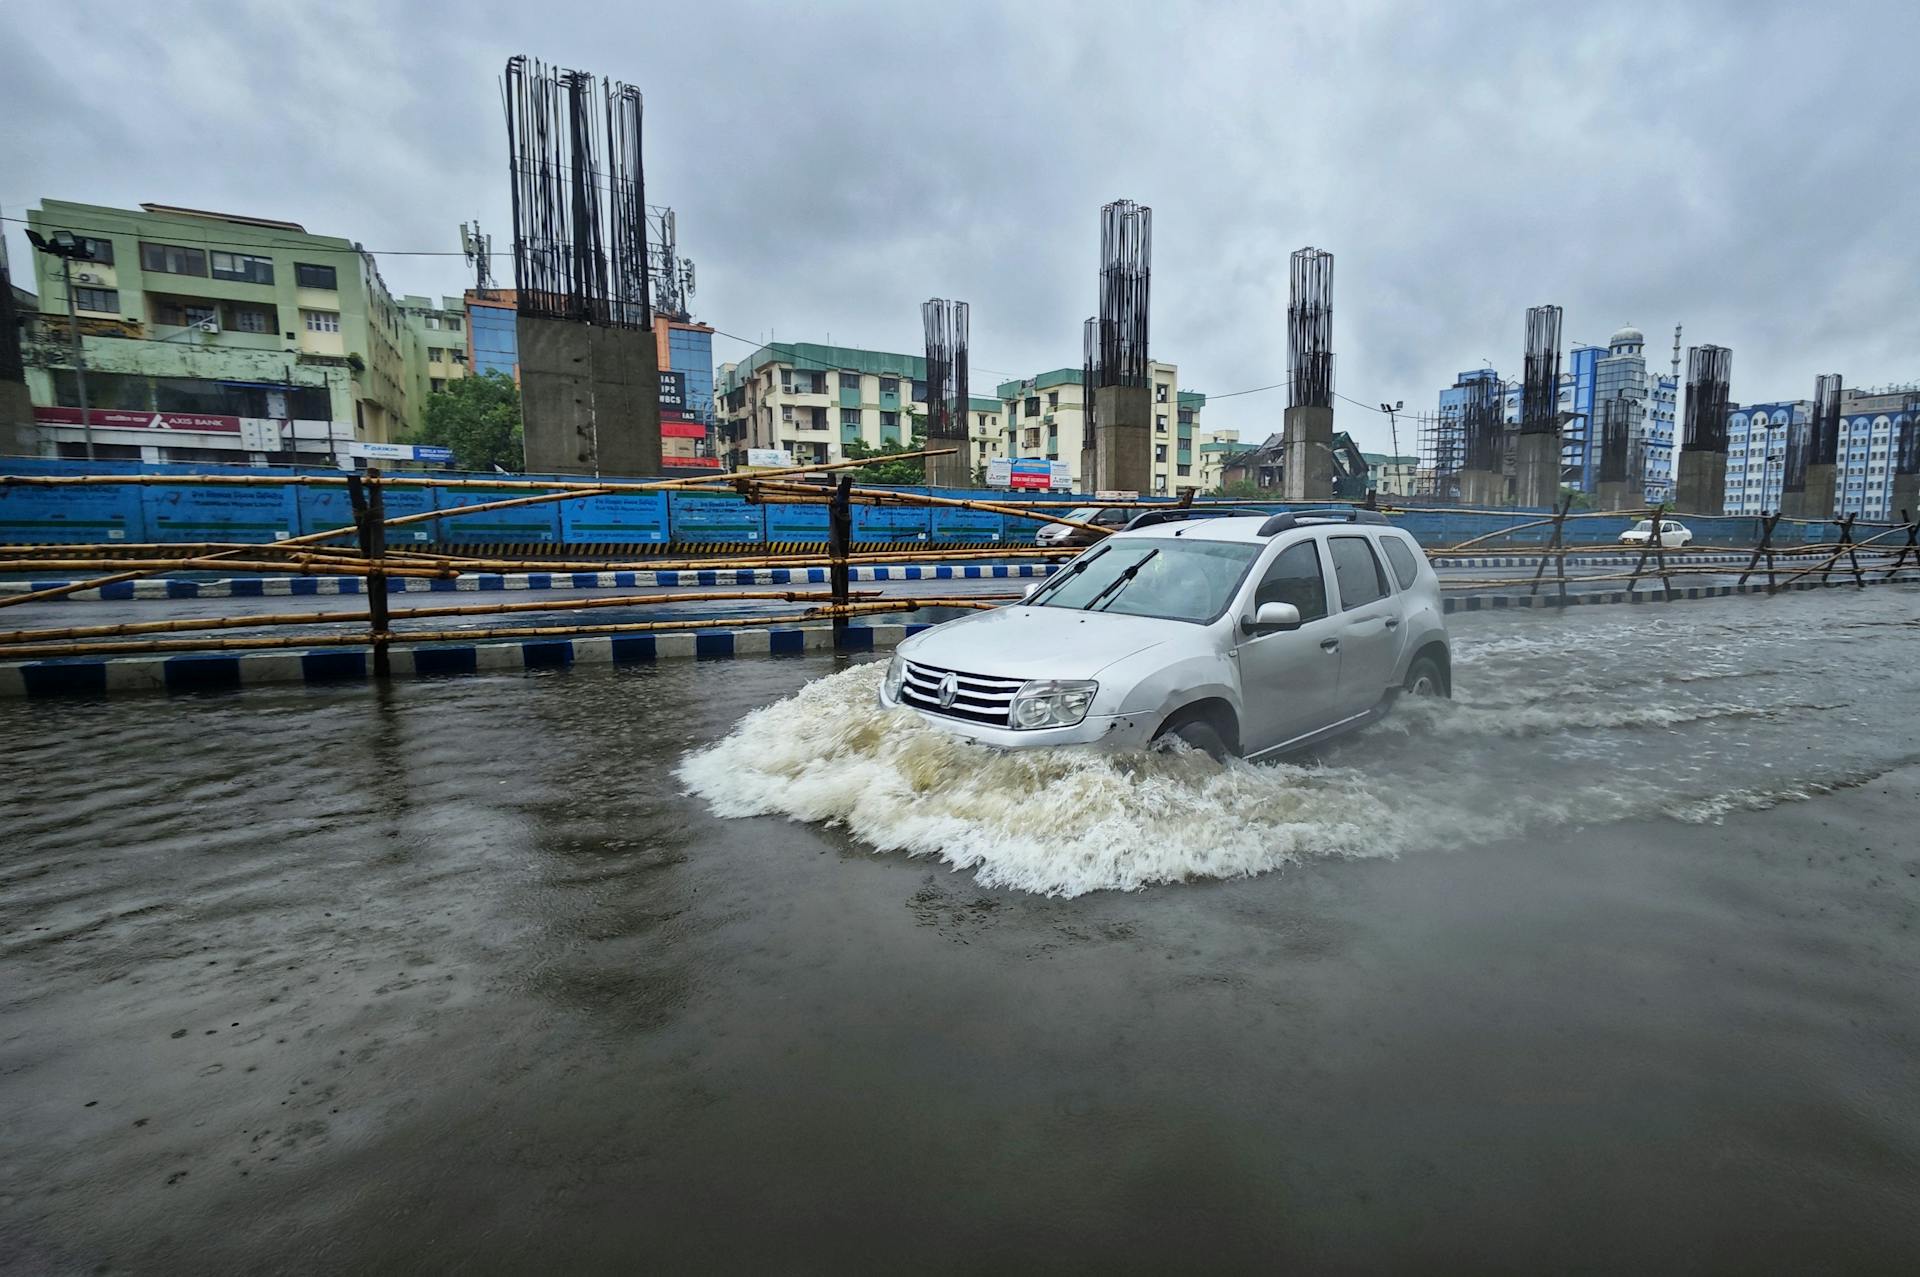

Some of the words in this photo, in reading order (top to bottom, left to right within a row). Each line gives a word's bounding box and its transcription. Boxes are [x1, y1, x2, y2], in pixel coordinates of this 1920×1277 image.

[660, 375, 676, 384] IAS
[661, 385, 676, 394] IPS
[682, 412, 695, 420] IAS
[169, 417, 192, 425] AXIS
[195, 418, 223, 427] BANK
